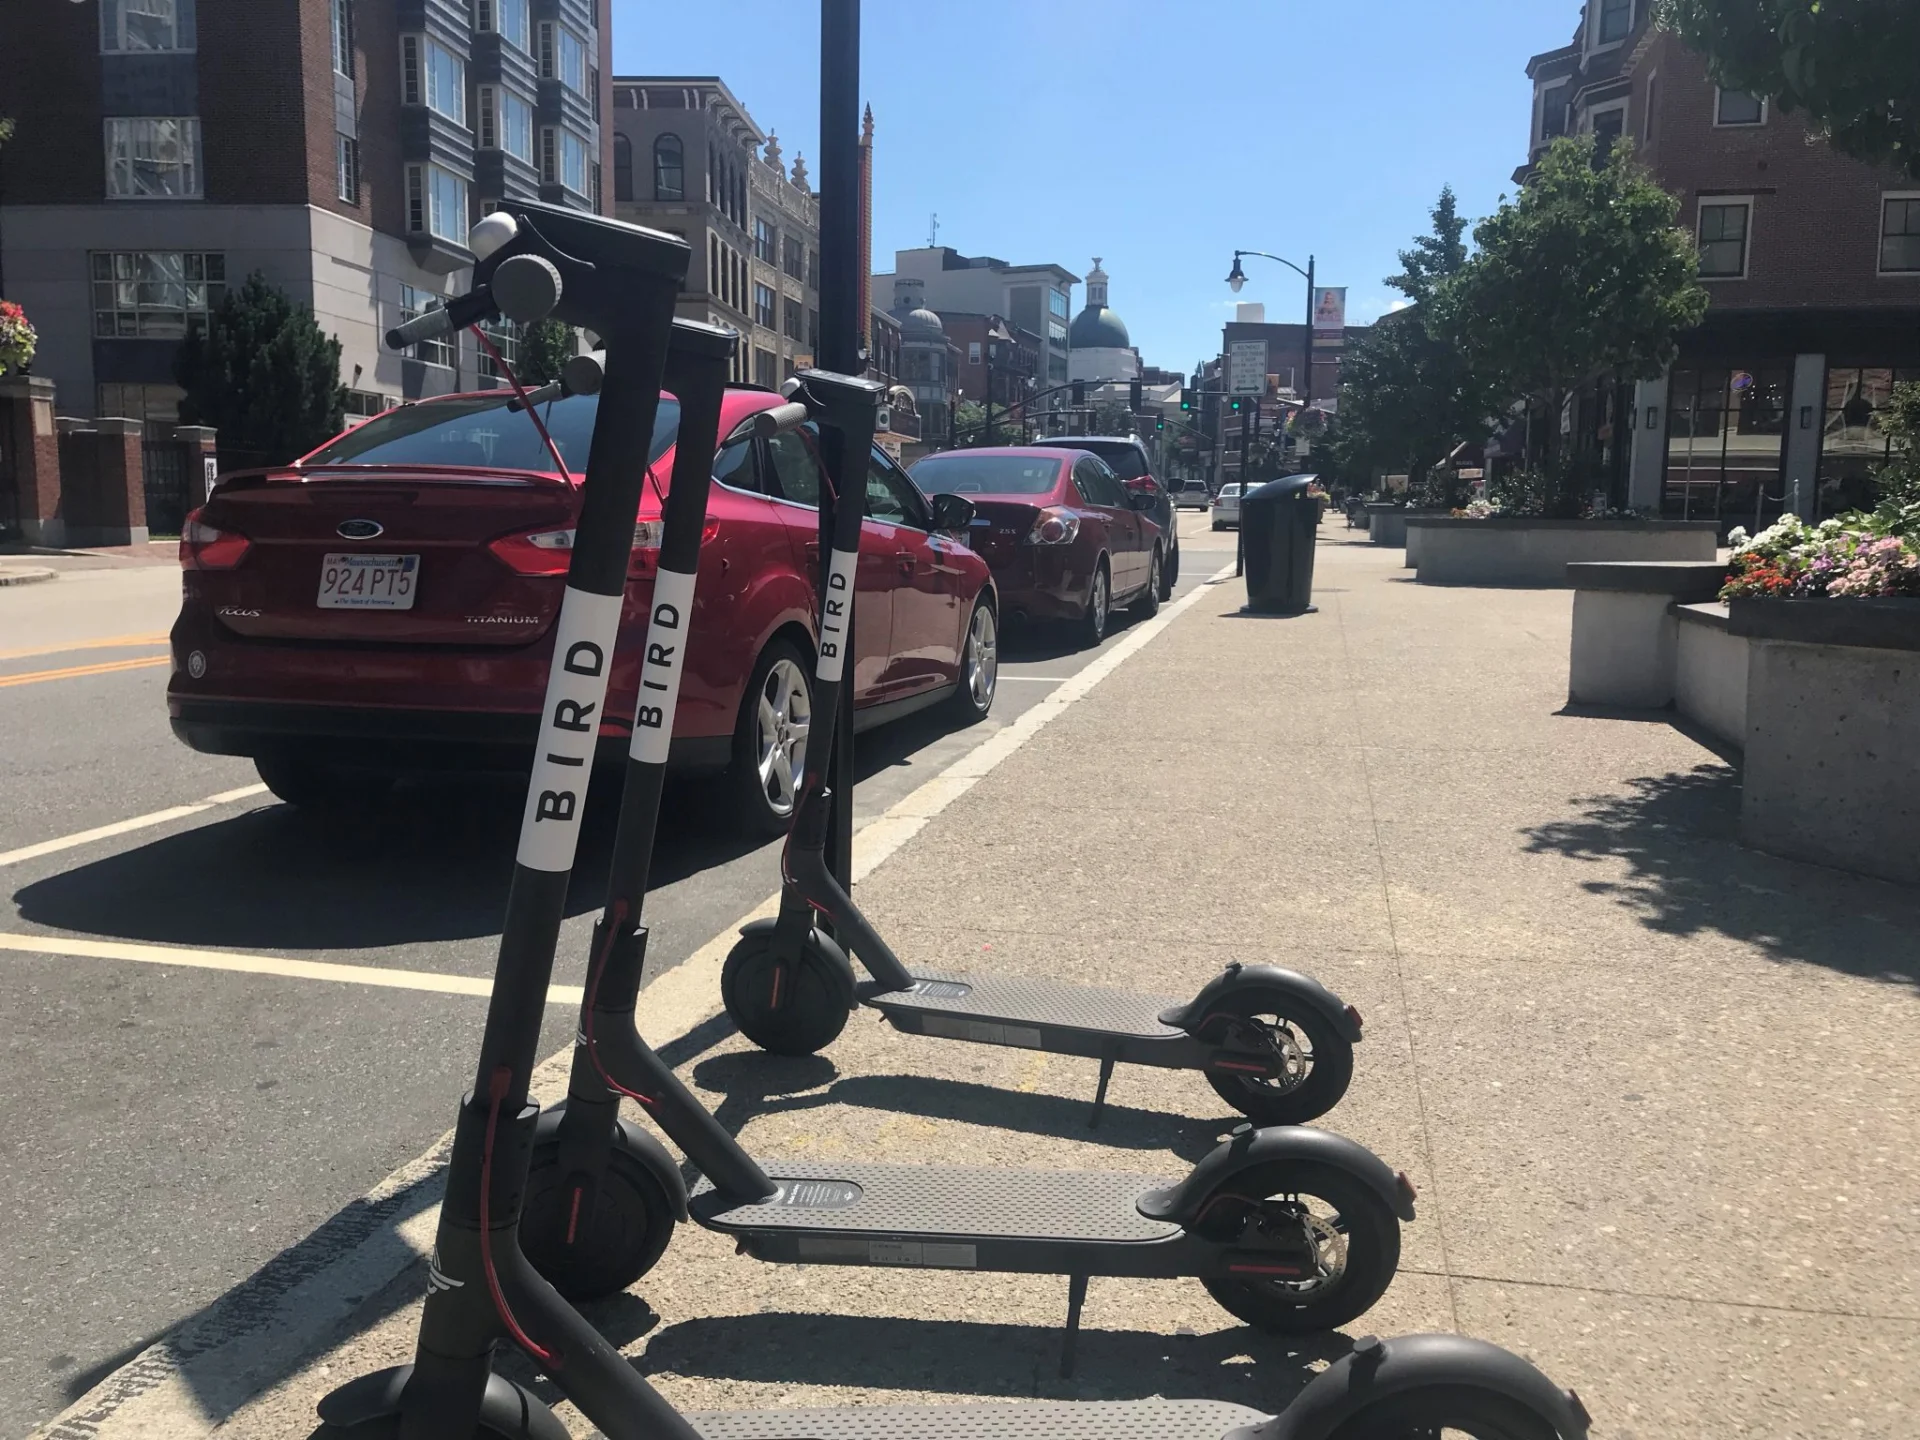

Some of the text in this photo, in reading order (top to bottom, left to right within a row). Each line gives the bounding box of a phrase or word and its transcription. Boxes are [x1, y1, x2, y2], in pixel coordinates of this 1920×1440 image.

[324, 568, 411, 596] 924 PT5
[464, 615, 539, 624] TITANIUM
[820, 572, 846, 658] BIRD
[637, 603, 680, 729] BIRD
[534, 640, 604, 823] BIRD
